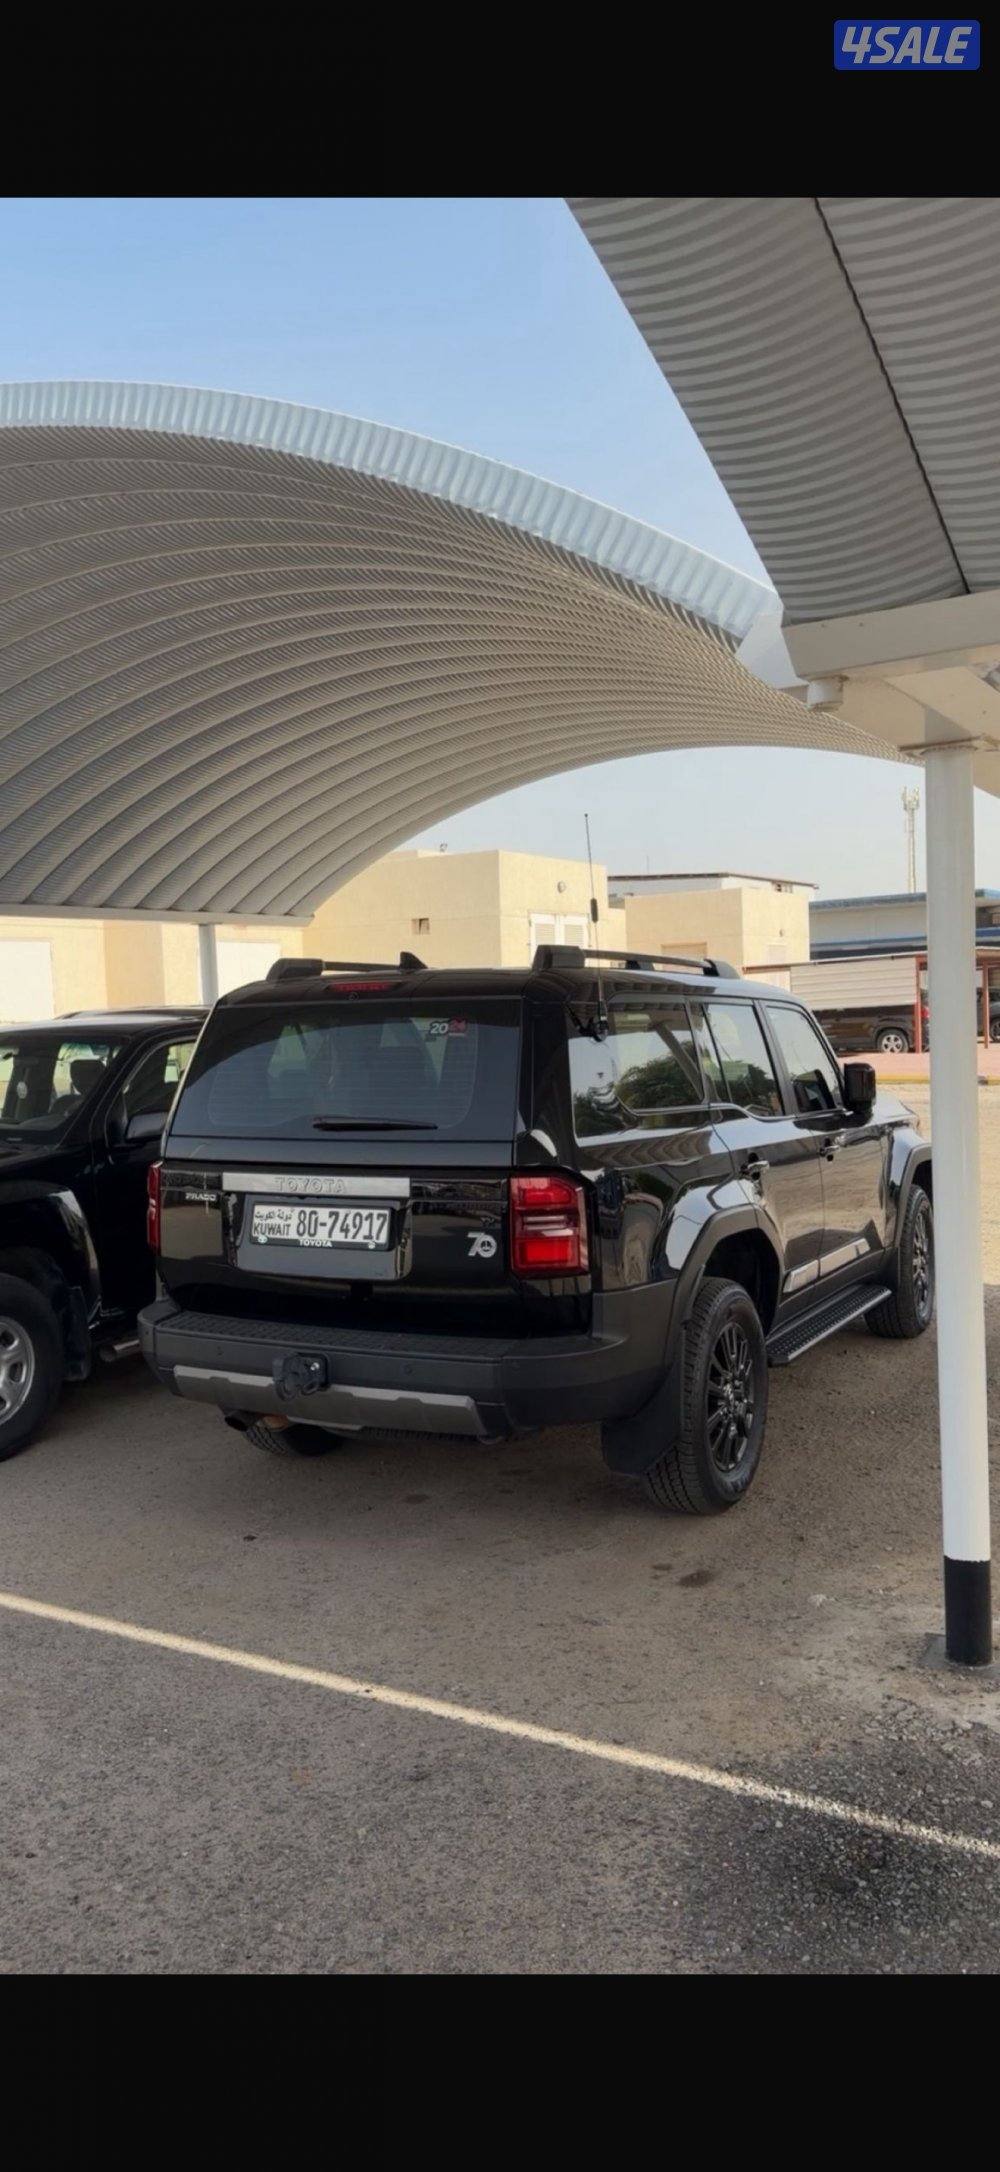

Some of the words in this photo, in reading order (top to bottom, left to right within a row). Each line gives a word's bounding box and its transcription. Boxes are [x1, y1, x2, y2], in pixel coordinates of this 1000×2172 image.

[275, 1177, 346, 1193] TOYOTA
[252, 1222, 291, 1236] KUWAIT
[296, 1209, 388, 1241] 80-74917
[299, 1239, 333, 1248] TOYOTA
[467, 1232, 498, 1258] 70
